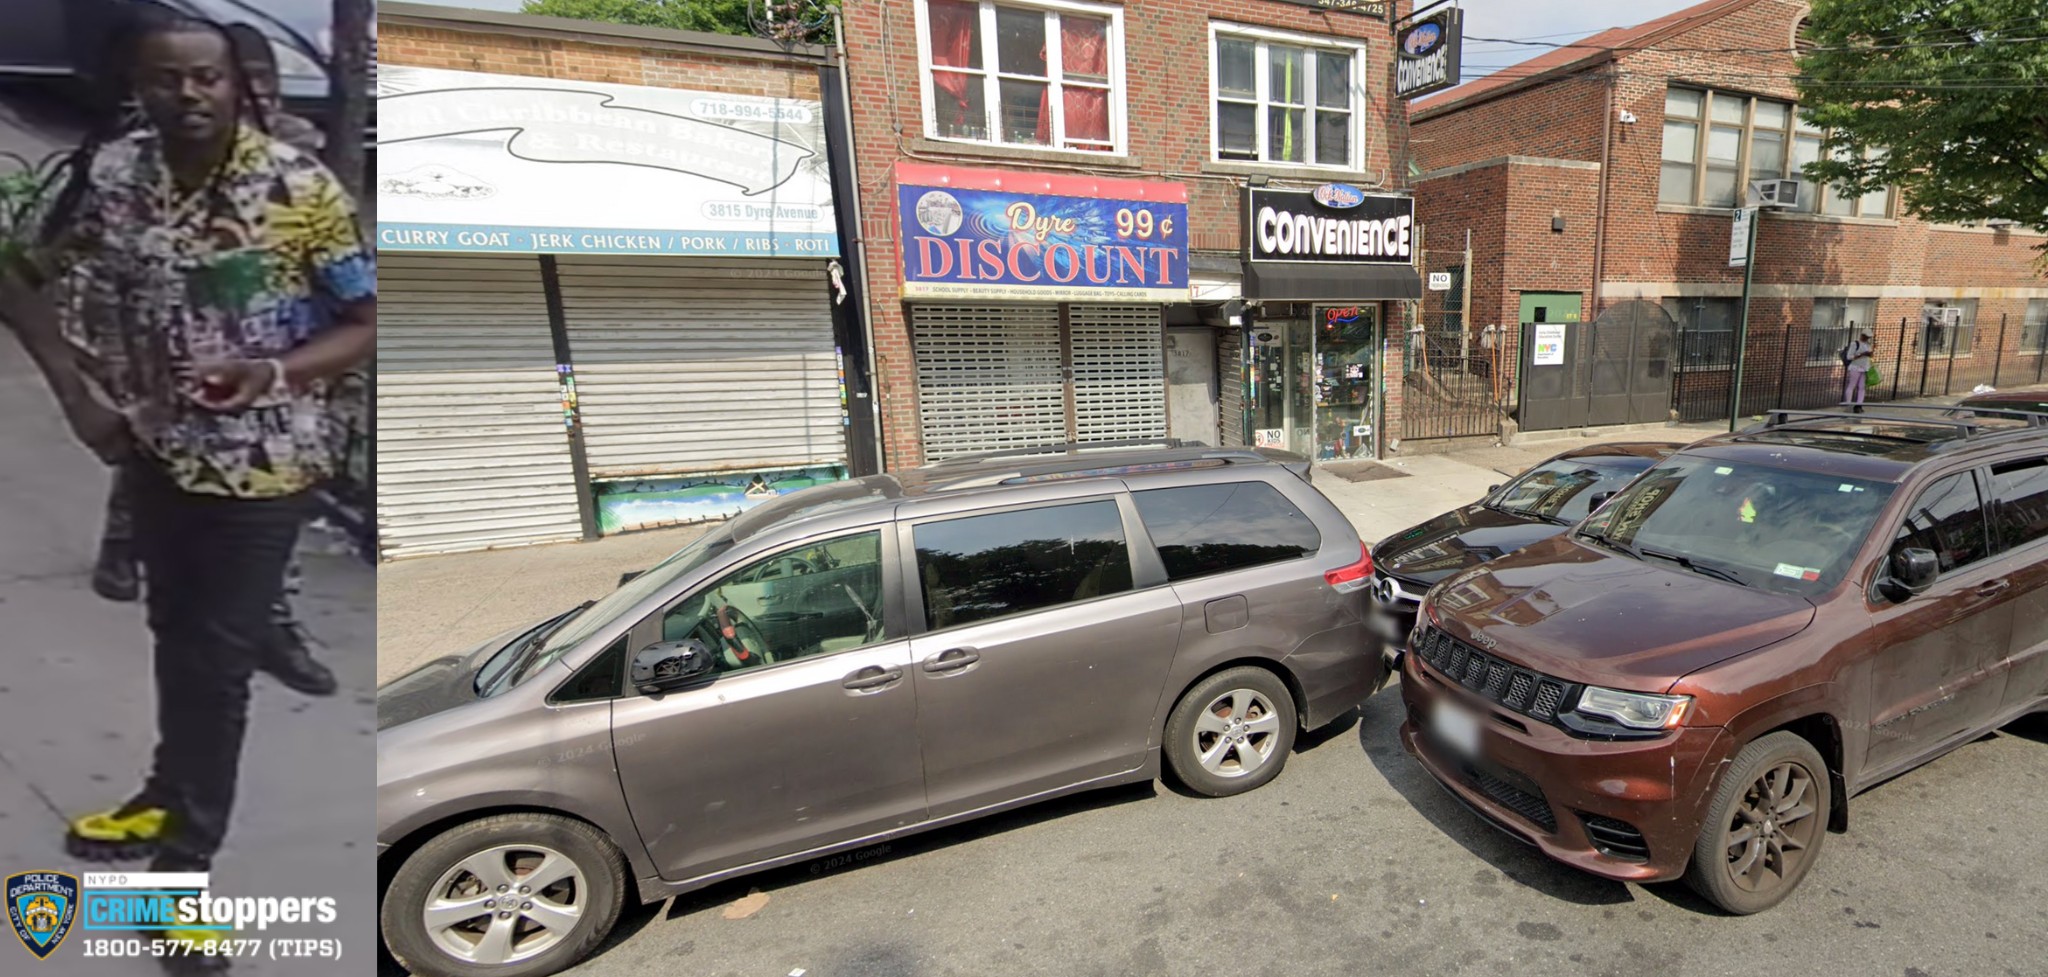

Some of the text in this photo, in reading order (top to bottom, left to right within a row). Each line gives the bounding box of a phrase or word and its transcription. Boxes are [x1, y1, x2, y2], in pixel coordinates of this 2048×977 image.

[1397, 44, 1447, 93] CONVENIENCE
[456, 103, 657, 134] Caribbean
[700, 102, 804, 121] 718-994-5544
[709, 204, 818, 220] 3815 Dyre Avenue
[1006, 202, 1075, 242] Dyre
[1115, 208, 1155, 240] 99
[381, 229, 449, 245] CURRY
[458, 231, 510, 246] GOAT
[530, 233, 575, 250] JERK
[581, 234, 661, 250] CHICKEN
[681, 237, 727, 250] PORK
[746, 238, 780, 251] RIBS
[795, 239, 829, 252] ROTI
[1257, 206, 1411, 257] CONVENIENCE
[914, 236, 1179, 285] DISCOUNT
[1432, 274, 1448, 282] NO
[1537, 343, 1557, 352] NYC
[1266, 430, 1281, 439] NO
[1470, 630, 1497, 649] Jeep
